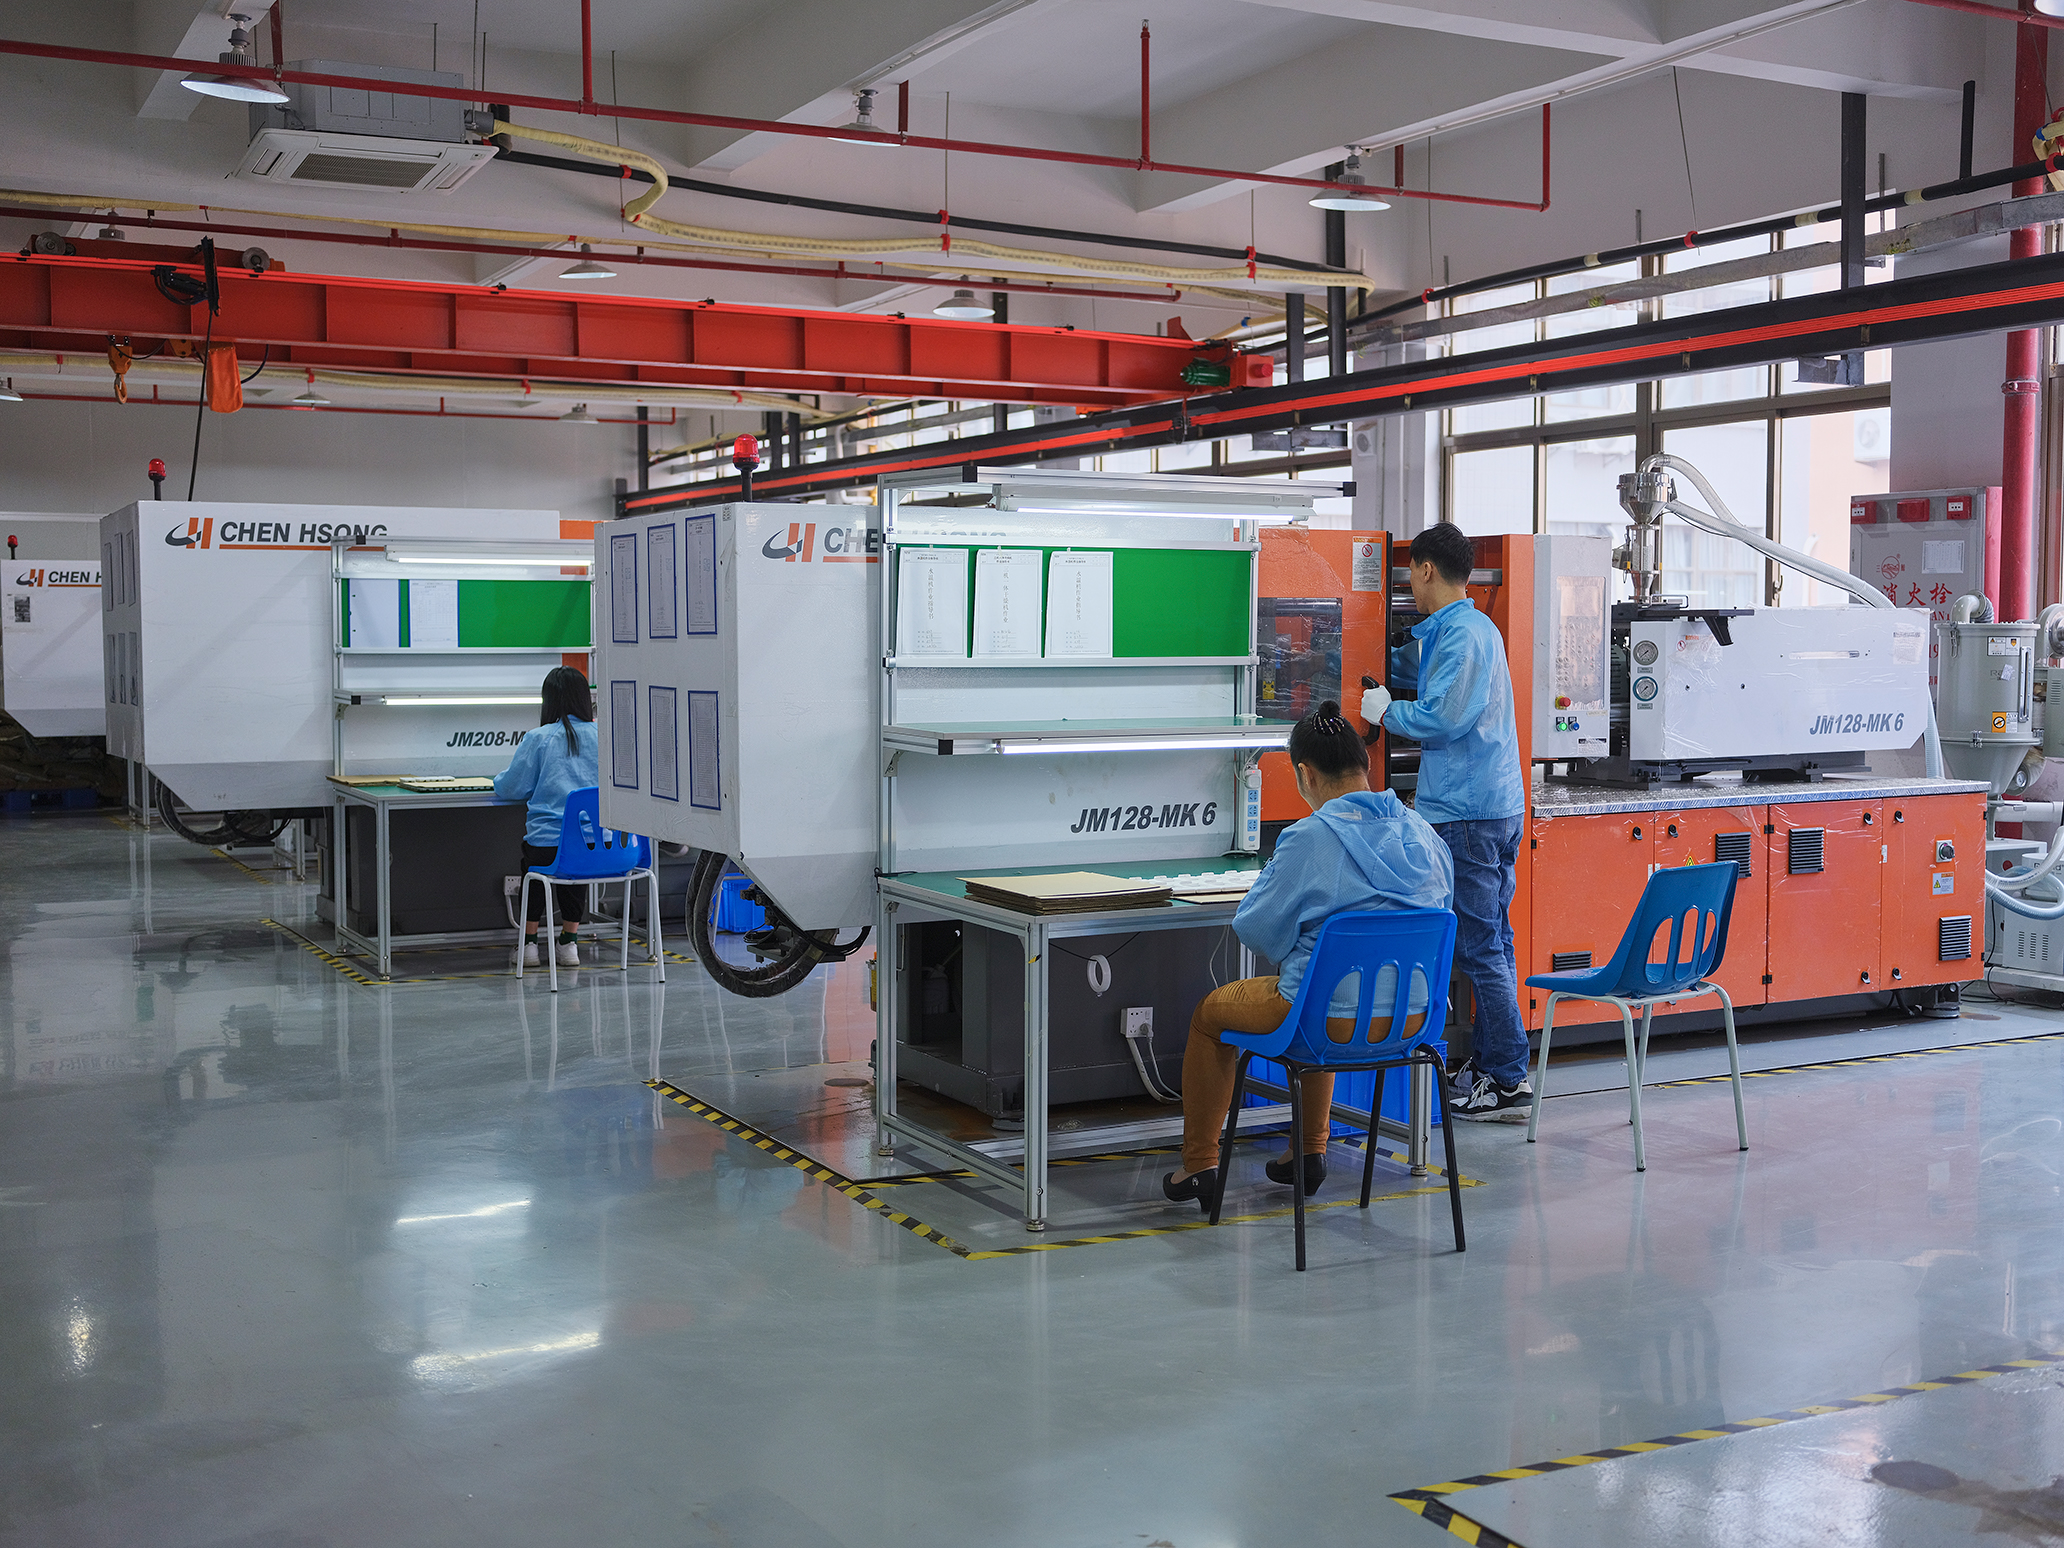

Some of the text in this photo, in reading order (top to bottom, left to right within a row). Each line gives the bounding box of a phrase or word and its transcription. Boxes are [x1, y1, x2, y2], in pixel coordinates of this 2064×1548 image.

[220, 521, 291, 543] CHEN
[824, 527, 878, 553] CHE
[48, 571, 90, 583] CHEN
[1881, 582, 1953, 607] 消火栓
[446, 731, 527, 748] JM208-M
